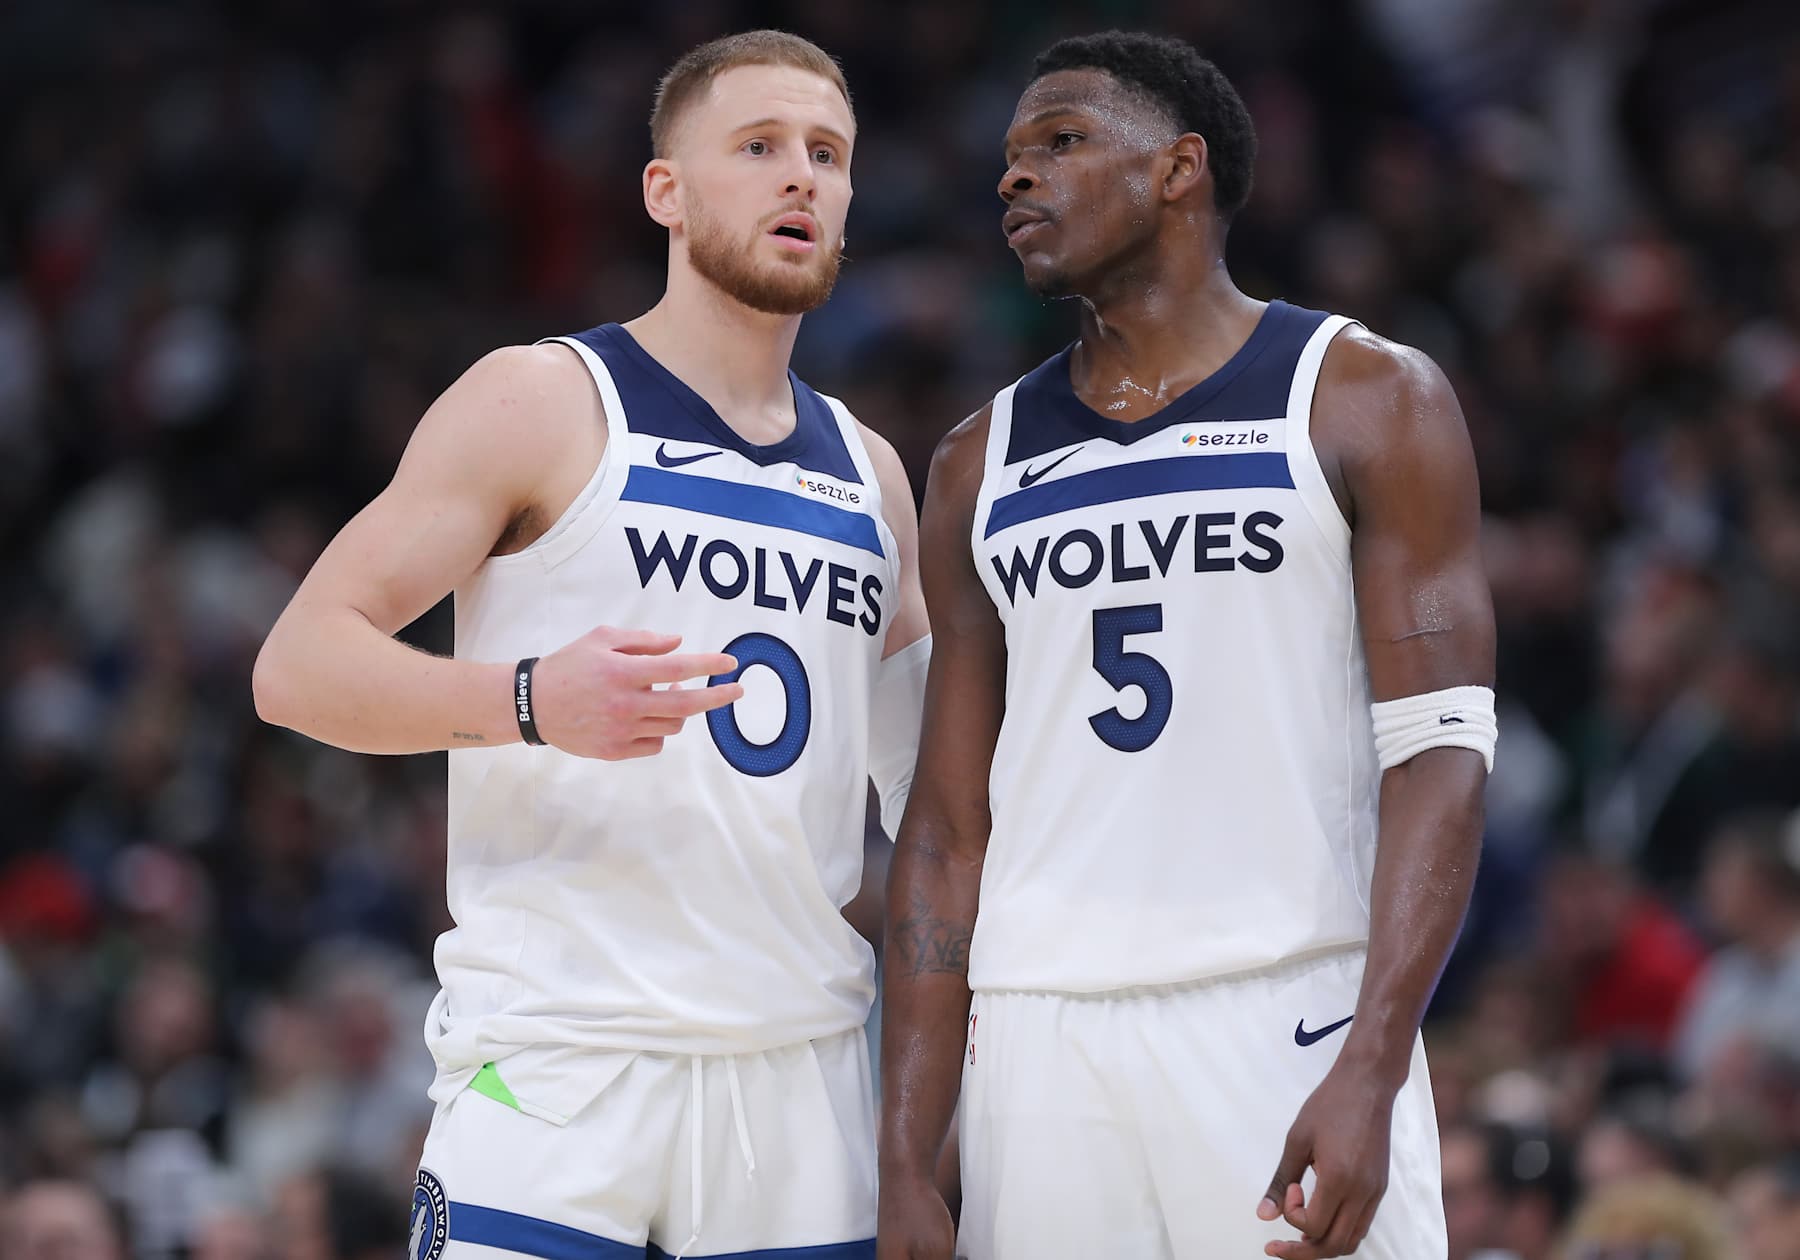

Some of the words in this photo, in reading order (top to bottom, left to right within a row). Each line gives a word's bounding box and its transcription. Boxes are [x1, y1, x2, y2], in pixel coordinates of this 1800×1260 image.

[1199, 429, 1269, 446] sezzle
[807, 481, 861, 504] sezzle
[624, 526, 883, 636] WOLVES
[991, 511, 1285, 609] WOLVES
[516, 672, 531, 722] Believe
[705, 632, 812, 777] 0
[1088, 603, 1173, 753] 5
